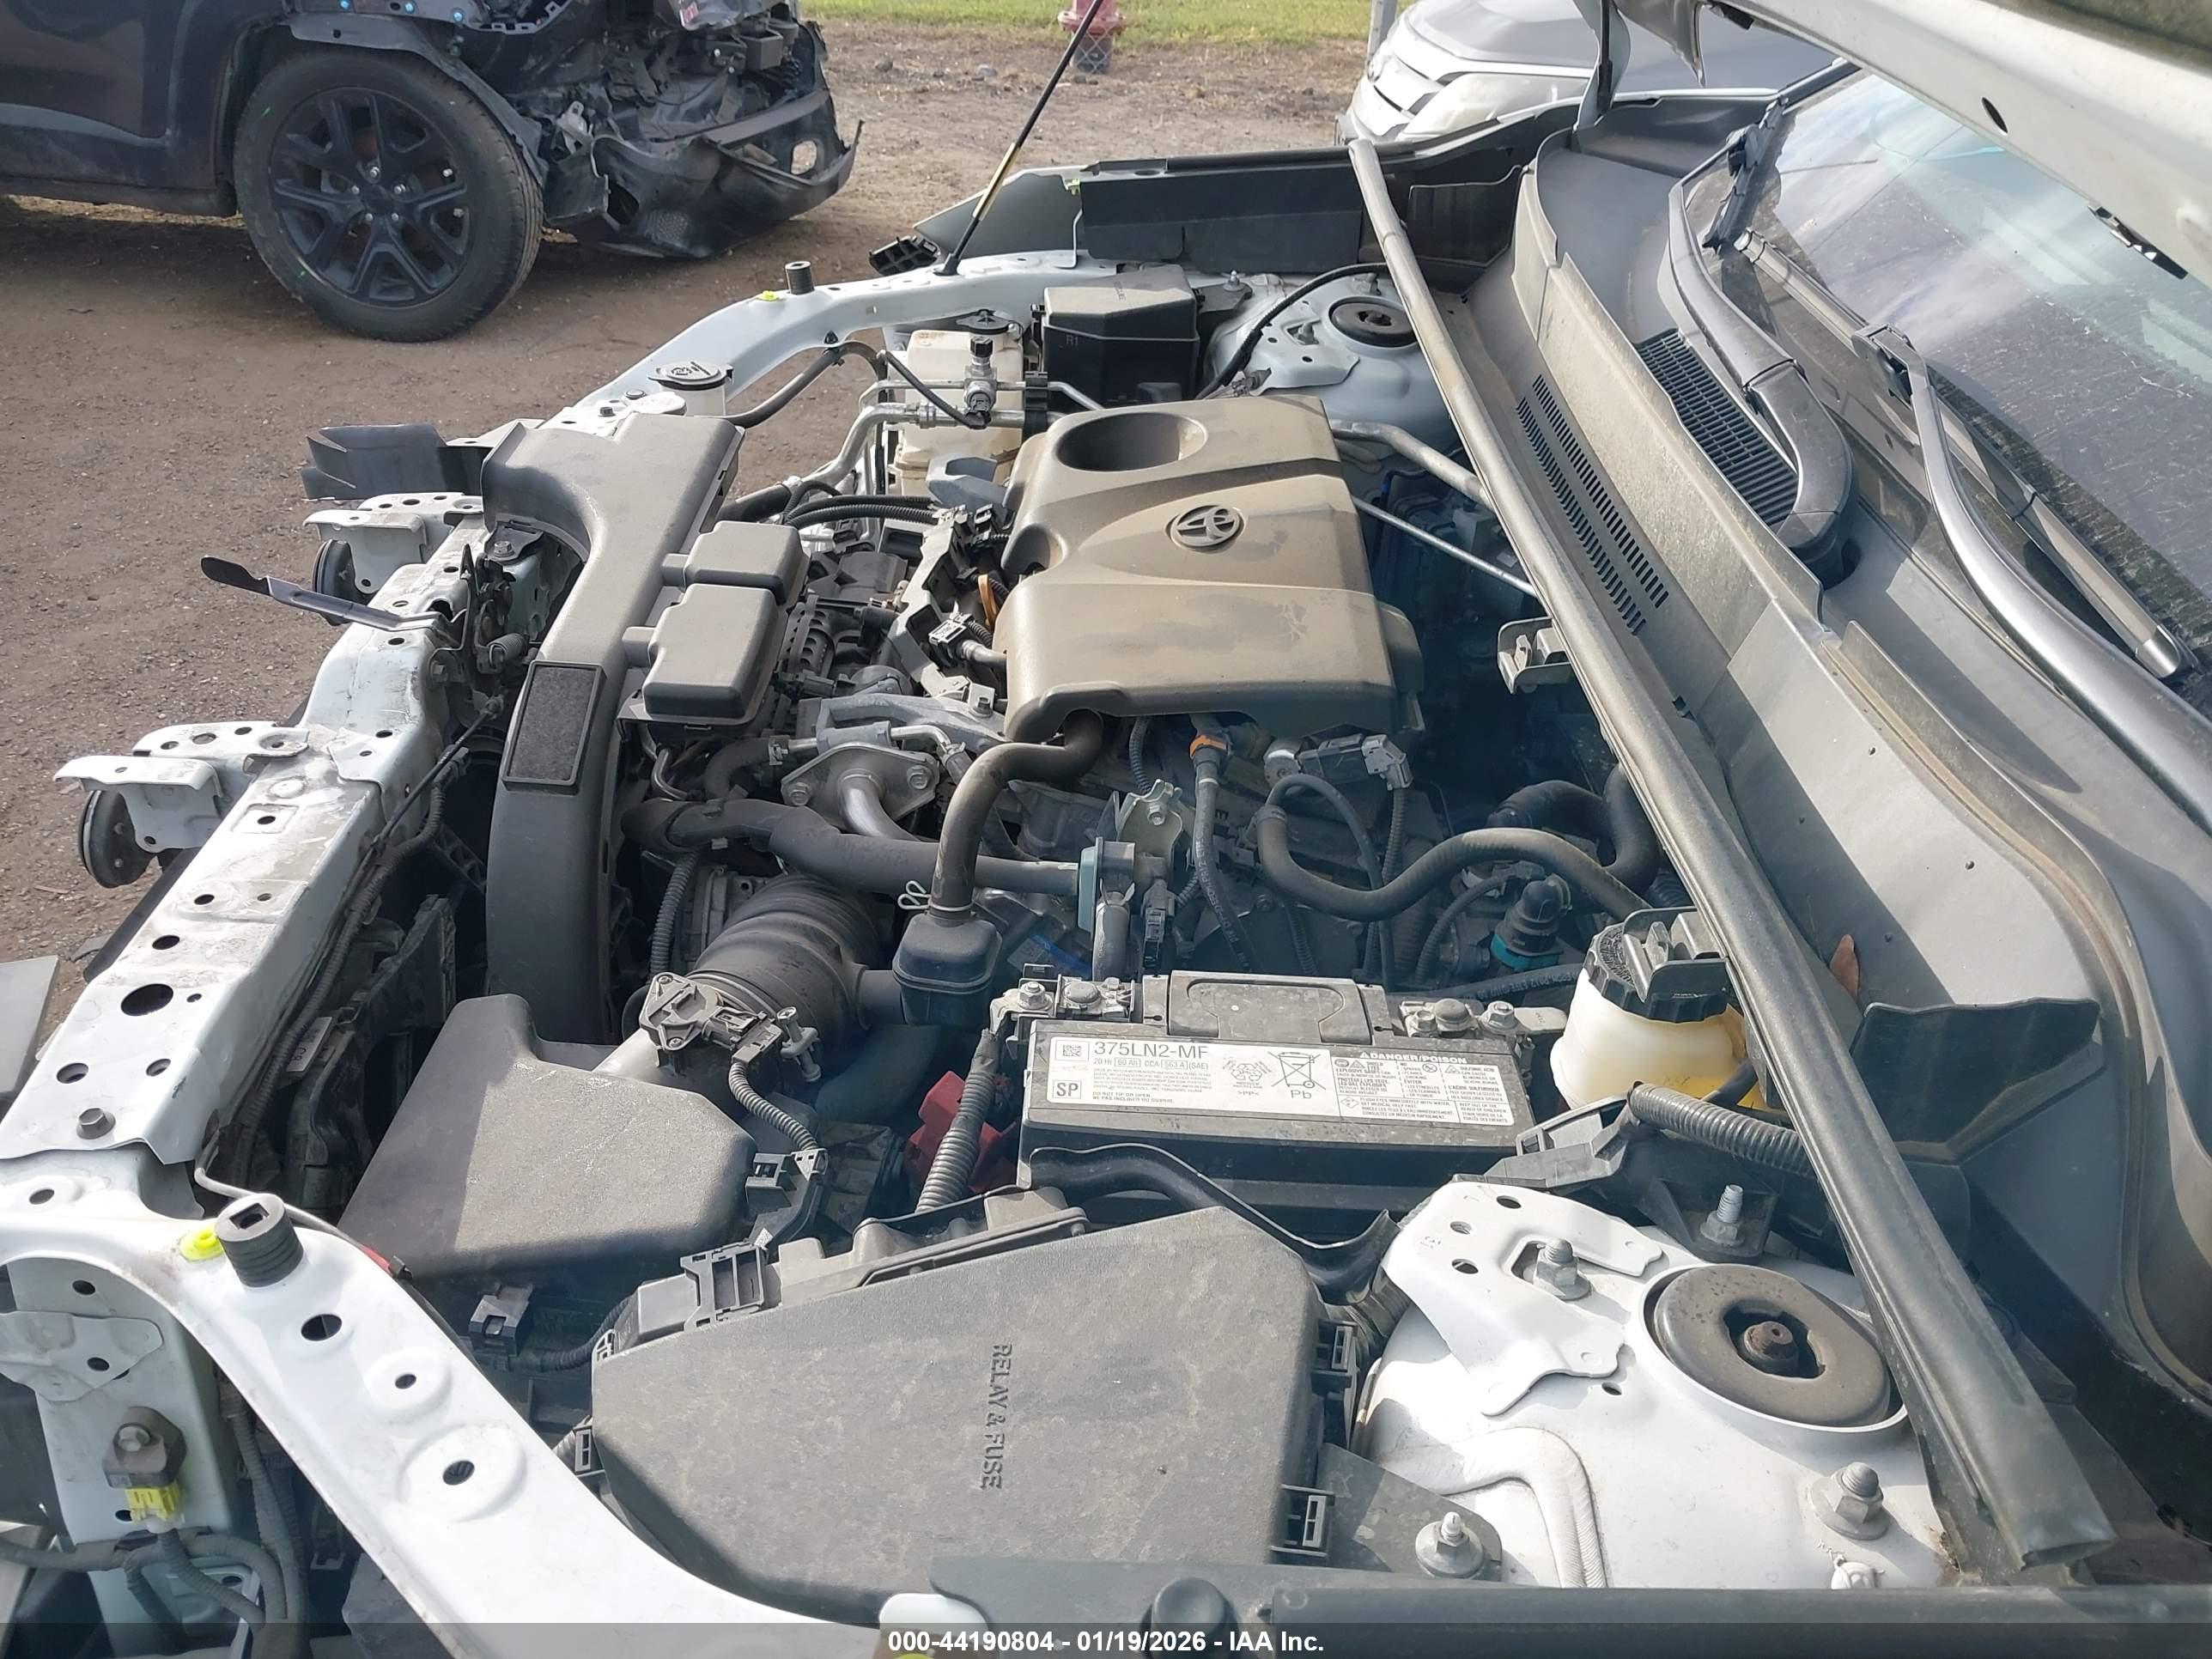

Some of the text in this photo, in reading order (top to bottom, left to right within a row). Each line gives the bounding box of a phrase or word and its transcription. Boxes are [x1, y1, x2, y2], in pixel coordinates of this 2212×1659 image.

[1093, 1041, 1209, 1059] 375LN2-MF
[1093, 1057, 1103, 1066] 20
[1188, 1061, 1209, 1071] (SAE)
[1370, 1053, 1468, 1064] DANGER/POISON
[1056, 1082, 1079, 1097] SP
[1291, 1089, 1312, 1099] Pb
[981, 1344, 1012, 1490] RELAY & FUSE
